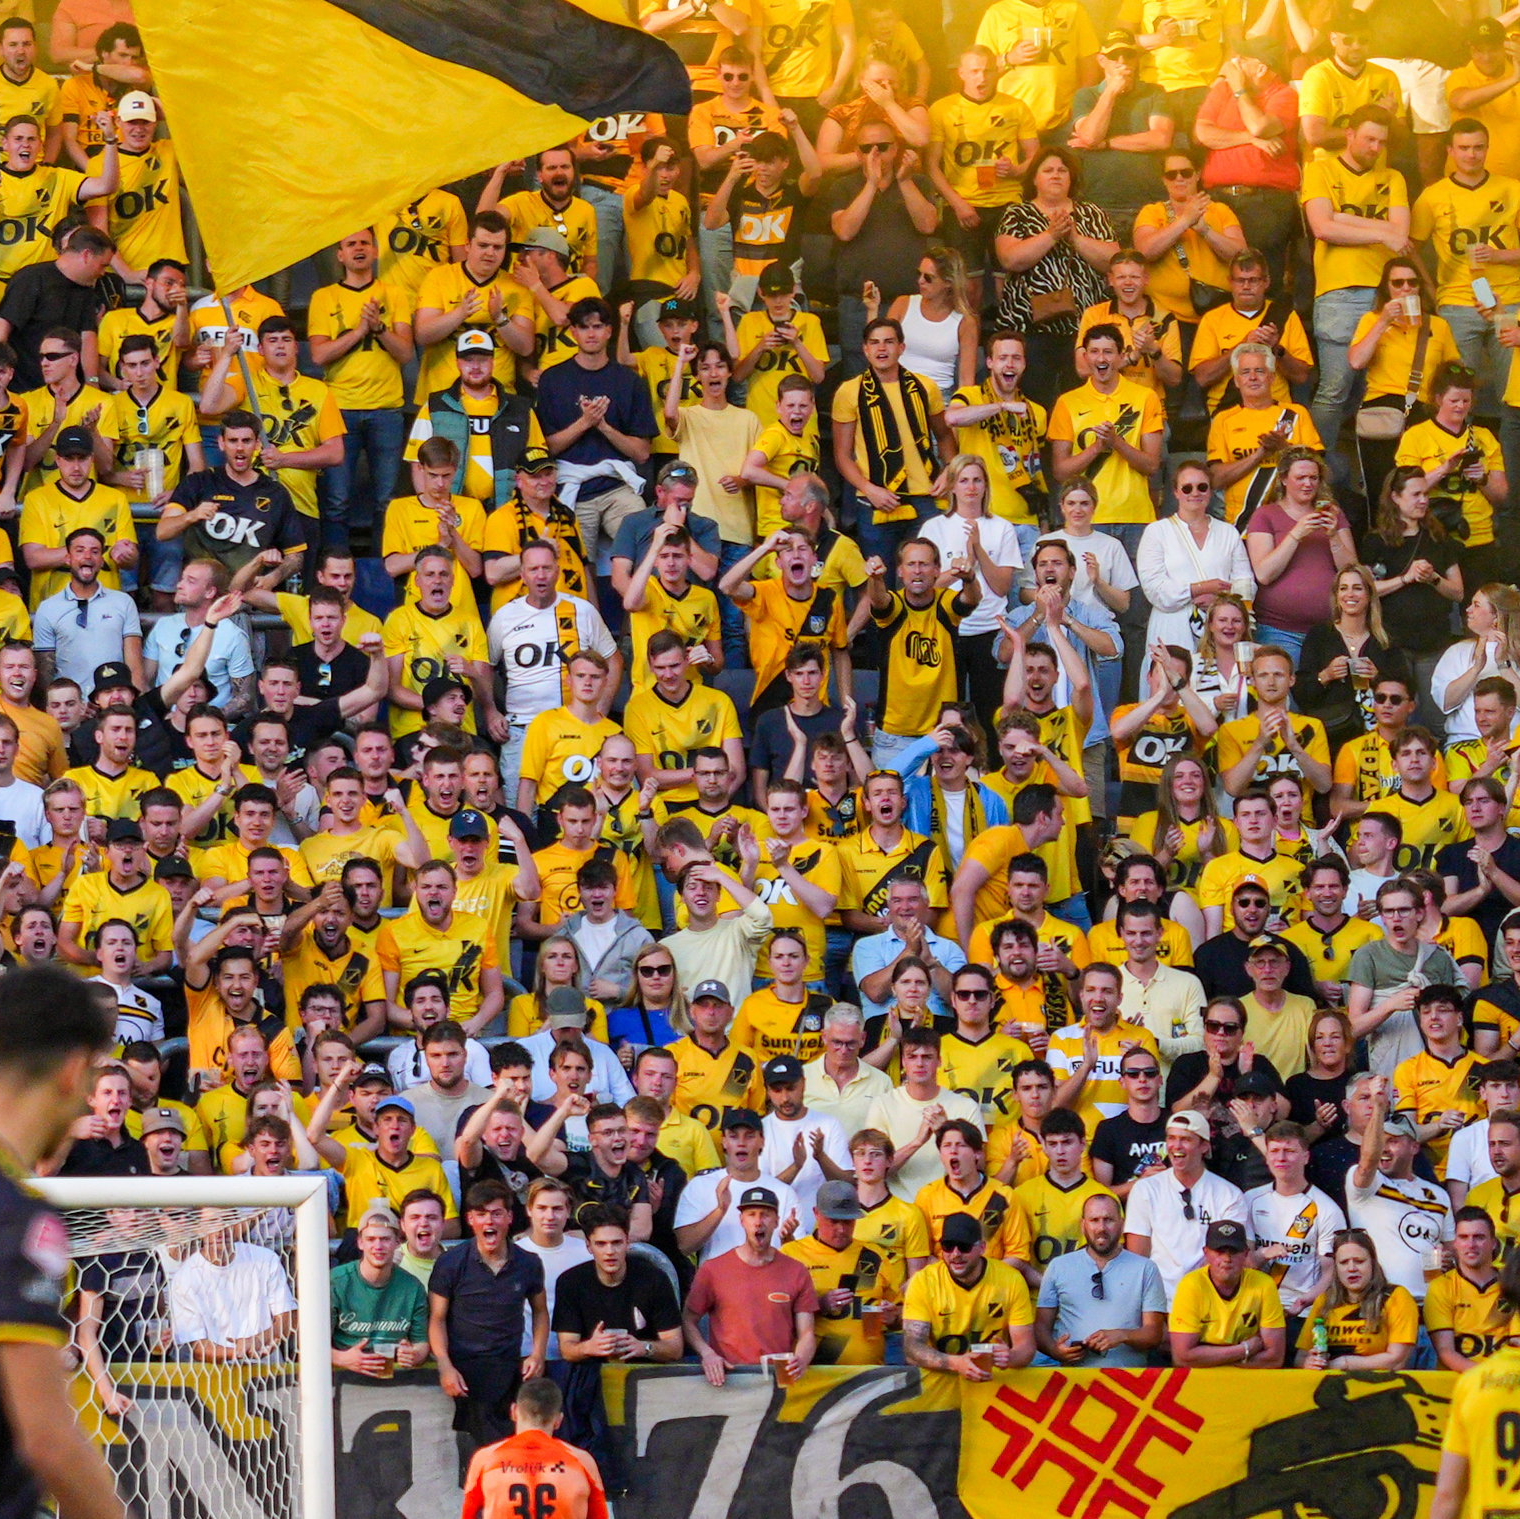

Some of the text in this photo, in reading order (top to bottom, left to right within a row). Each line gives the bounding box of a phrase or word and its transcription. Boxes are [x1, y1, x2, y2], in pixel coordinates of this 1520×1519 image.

[592, 114, 645, 140] OK
[954, 140, 1009, 165] OK
[115, 181, 169, 218] OK
[739, 215, 785, 239] OK
[1450, 228, 1506, 252] OK
[389, 226, 440, 261] OK
[754, 349, 801, 371] OK
[204, 514, 265, 547] OK
[513, 641, 576, 670] OK
[756, 878, 797, 906] OK
[761, 1034, 823, 1048] Sunweb
